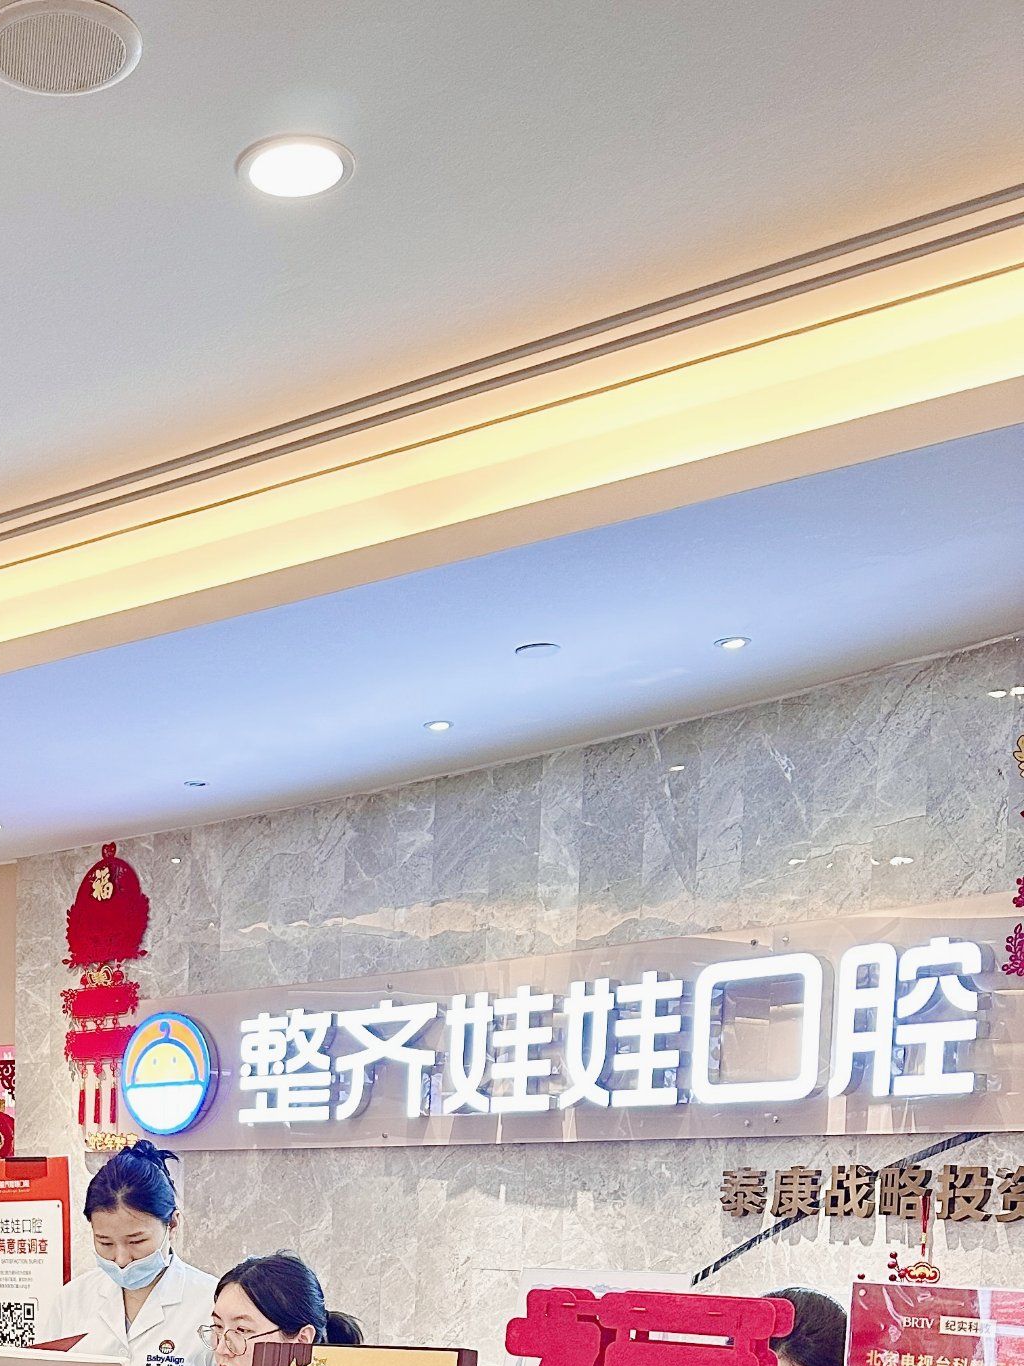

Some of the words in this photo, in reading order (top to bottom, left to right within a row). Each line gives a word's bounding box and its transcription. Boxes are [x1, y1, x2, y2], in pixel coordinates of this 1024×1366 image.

[238, 935, 984, 1126] 整齐娃娃口腔
[903, 1316, 935, 1330] BRTV
[146, 1354, 185, 1365] BabyAlign
